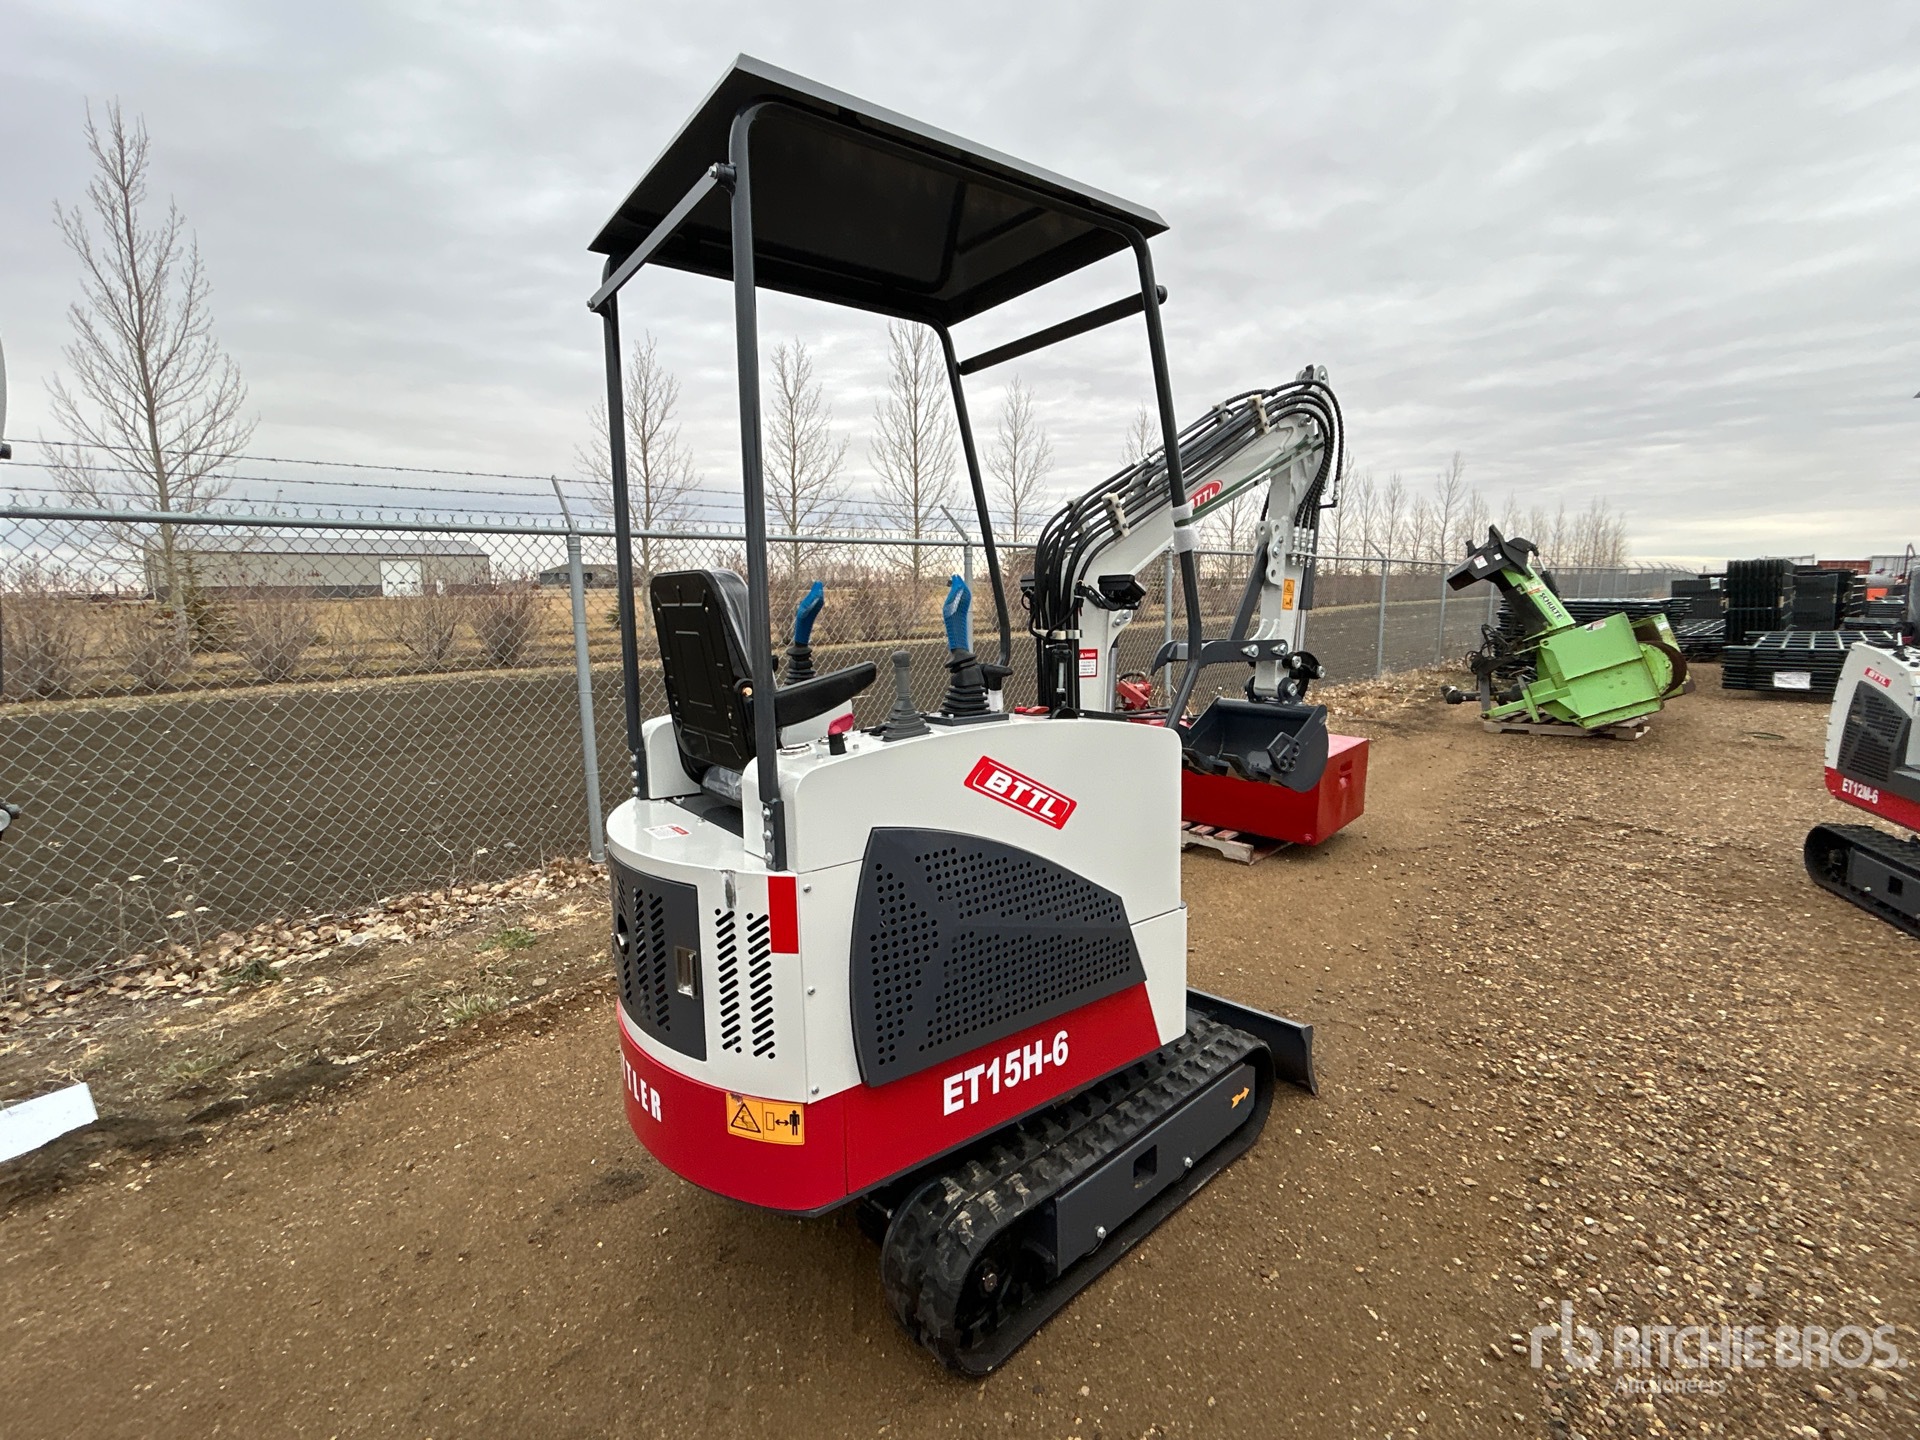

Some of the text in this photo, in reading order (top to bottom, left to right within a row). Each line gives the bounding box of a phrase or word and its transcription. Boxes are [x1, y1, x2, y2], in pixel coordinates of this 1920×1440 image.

[1193, 487, 1216, 508] TTL
[1540, 592, 1563, 618] SCHULTE
[1867, 669, 1887, 686] BTTL
[983, 769, 1057, 819] BTTL
[1842, 777, 1879, 804] ET12M-6
[943, 1030, 1069, 1117] ET15H-6
